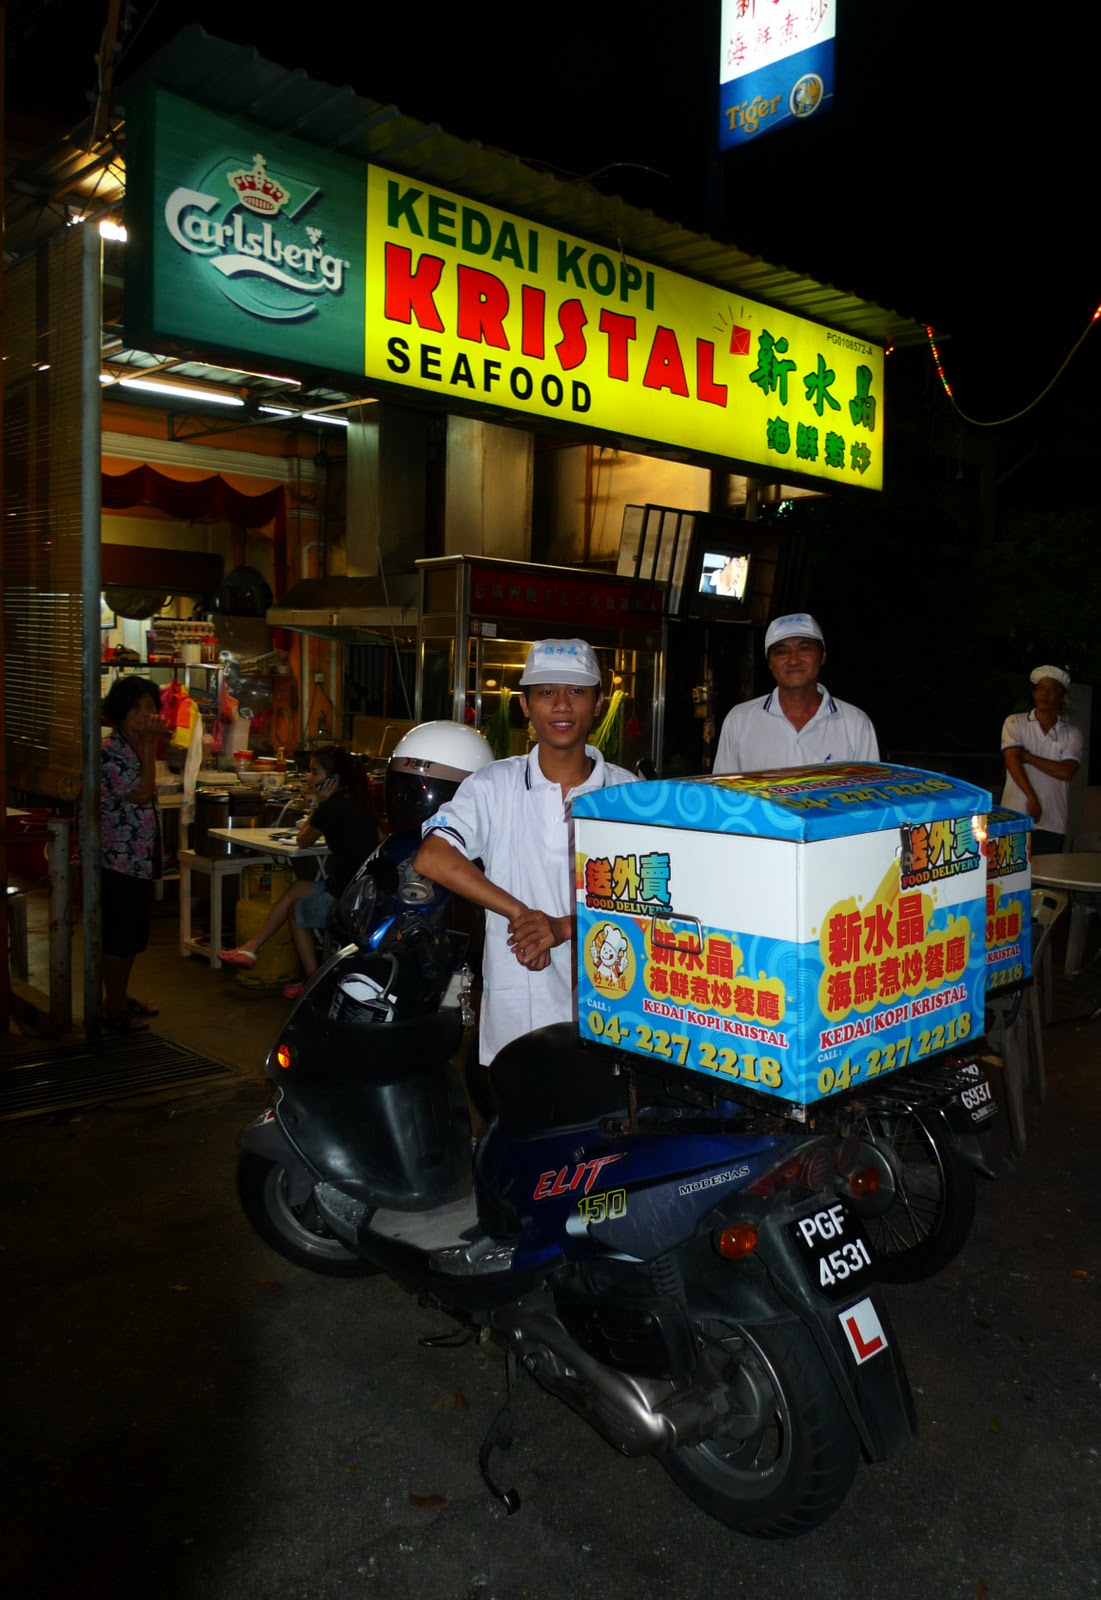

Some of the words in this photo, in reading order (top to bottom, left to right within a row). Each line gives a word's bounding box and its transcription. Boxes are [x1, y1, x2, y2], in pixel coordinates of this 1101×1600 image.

[726, 95, 782, 133] Tiger
[165, 187, 350, 292] Carlsberg
[388, 180, 538, 273] KEDAI
[557, 239, 655, 311] KOPI
[385, 241, 727, 408] KRISTAL
[387, 337, 591, 413] SEAFOOD
[749, 329, 876, 432] 新水晶
[586, 853, 671, 904] 送外賣
[902, 870, 930, 890] FOOD
[931, 856, 979, 881] DELIVERY
[587, 897, 614, 911] FOOD
[651, 929, 734, 980] 新水晶
[828, 894, 924, 968] 新水晶
[987, 945, 1020, 963] KRISTAL
[991, 963, 1022, 988] 2218
[643, 999, 685, 1021] KEDAI
[687, 1010, 720, 1030] KOPI
[723, 1019, 788, 1048] KRISTAL
[820, 1018, 871, 1049] KEDAI
[873, 1003, 908, 1032] KOPI
[911, 985, 966, 1018] KRISTAL
[588, 1011, 630, 1044] 04-
[636, 1024, 690, 1065] 227
[699, 1043, 782, 1088] 2218
[817, 1057, 861, 1095] 04-
[865, 1036, 912, 1078] 227
[917, 1012, 972, 1056] 2218
[961, 1081, 992, 1110] 6937
[679, 1165, 750, 1196] MODENAS
[578, 1188, 627, 1224] 150
[799, 1205, 847, 1248] PGF
[818, 1238, 871, 1287] 4531
[846, 1316, 883, 1361] L
